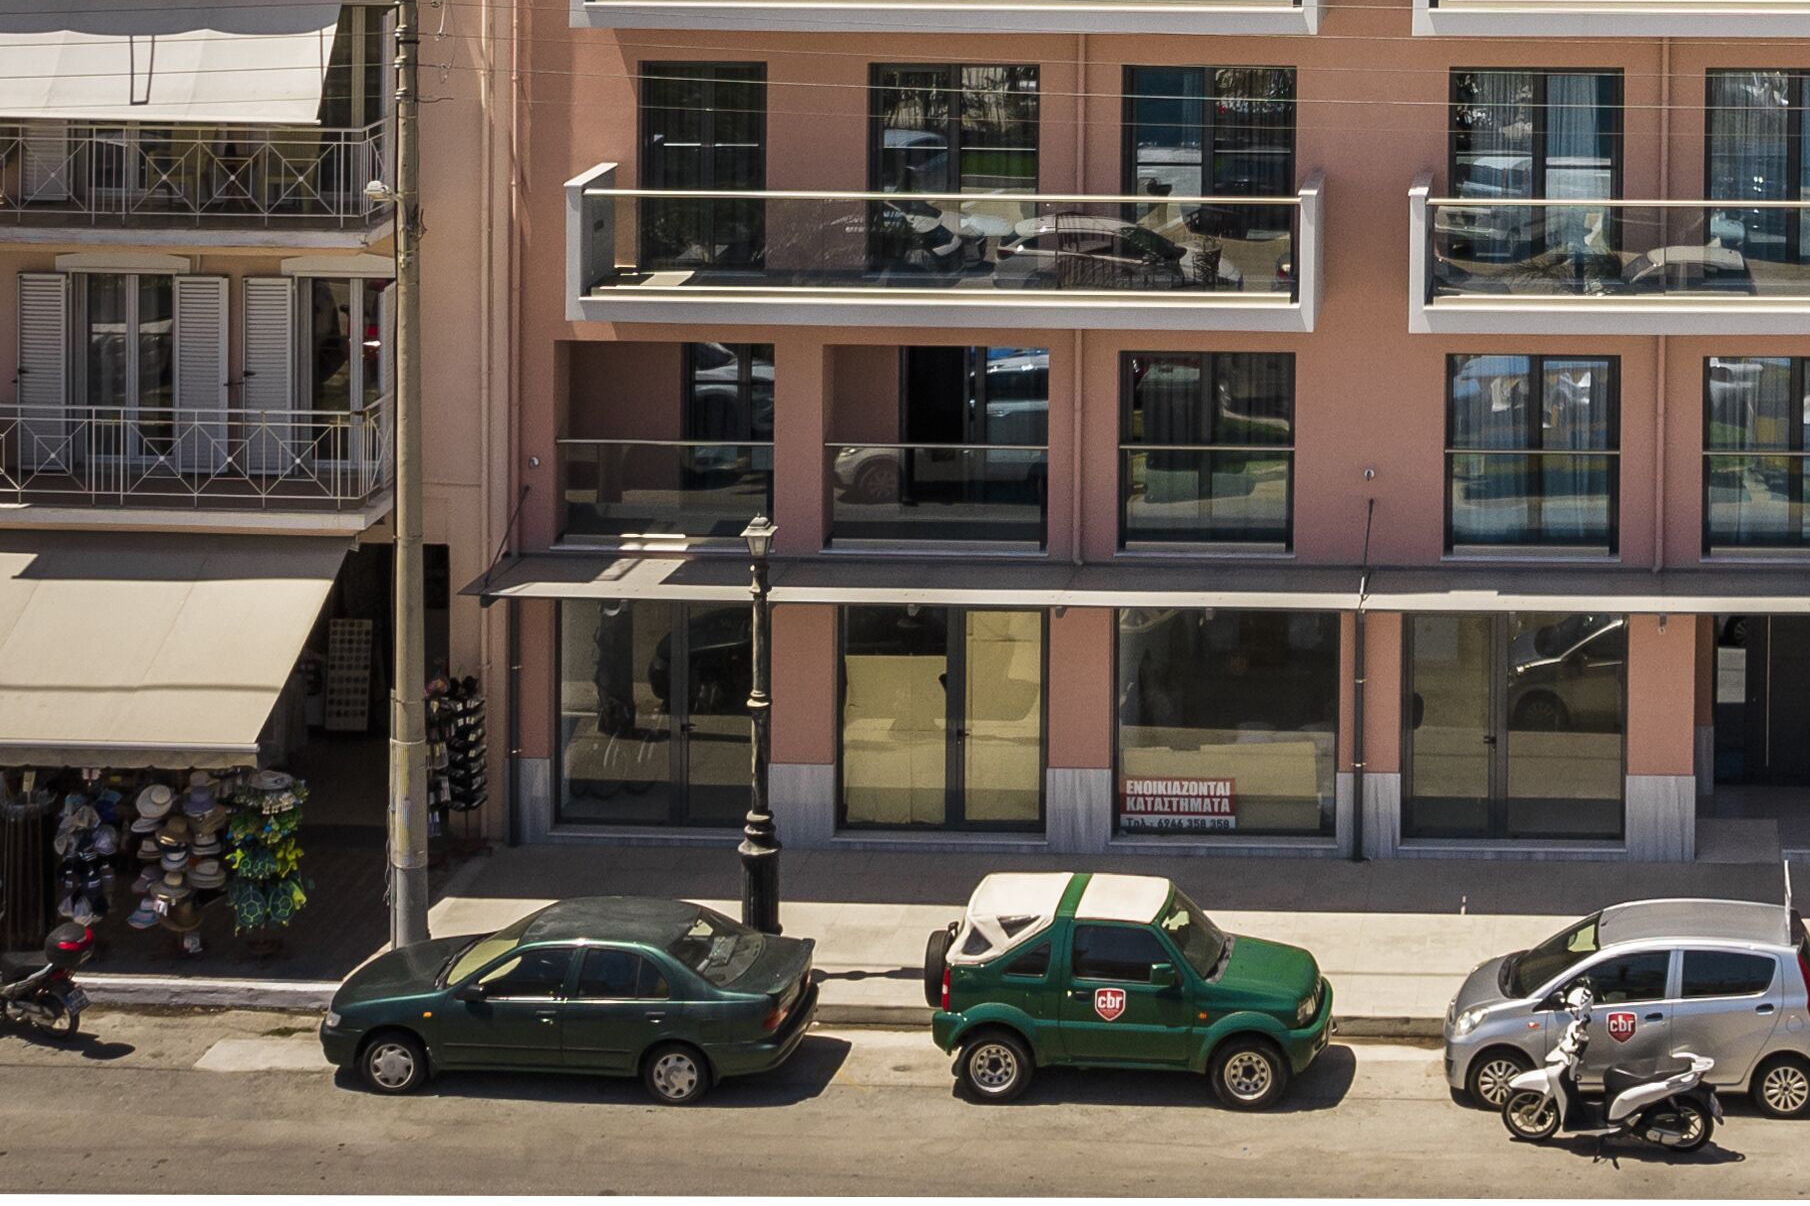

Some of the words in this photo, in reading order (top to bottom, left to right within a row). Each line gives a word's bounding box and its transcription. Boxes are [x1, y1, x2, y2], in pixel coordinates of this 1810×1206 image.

[1126, 780, 1231, 796] ΕΝΟΙΚΙΑΖΟΝΤΑΙ
[1126, 796, 1231, 812] ΚΑΤΑΣΤΗΜΑΤΑ
[1097, 991, 1123, 1009] cbr
[1610, 1015, 1635, 1032] cbr
